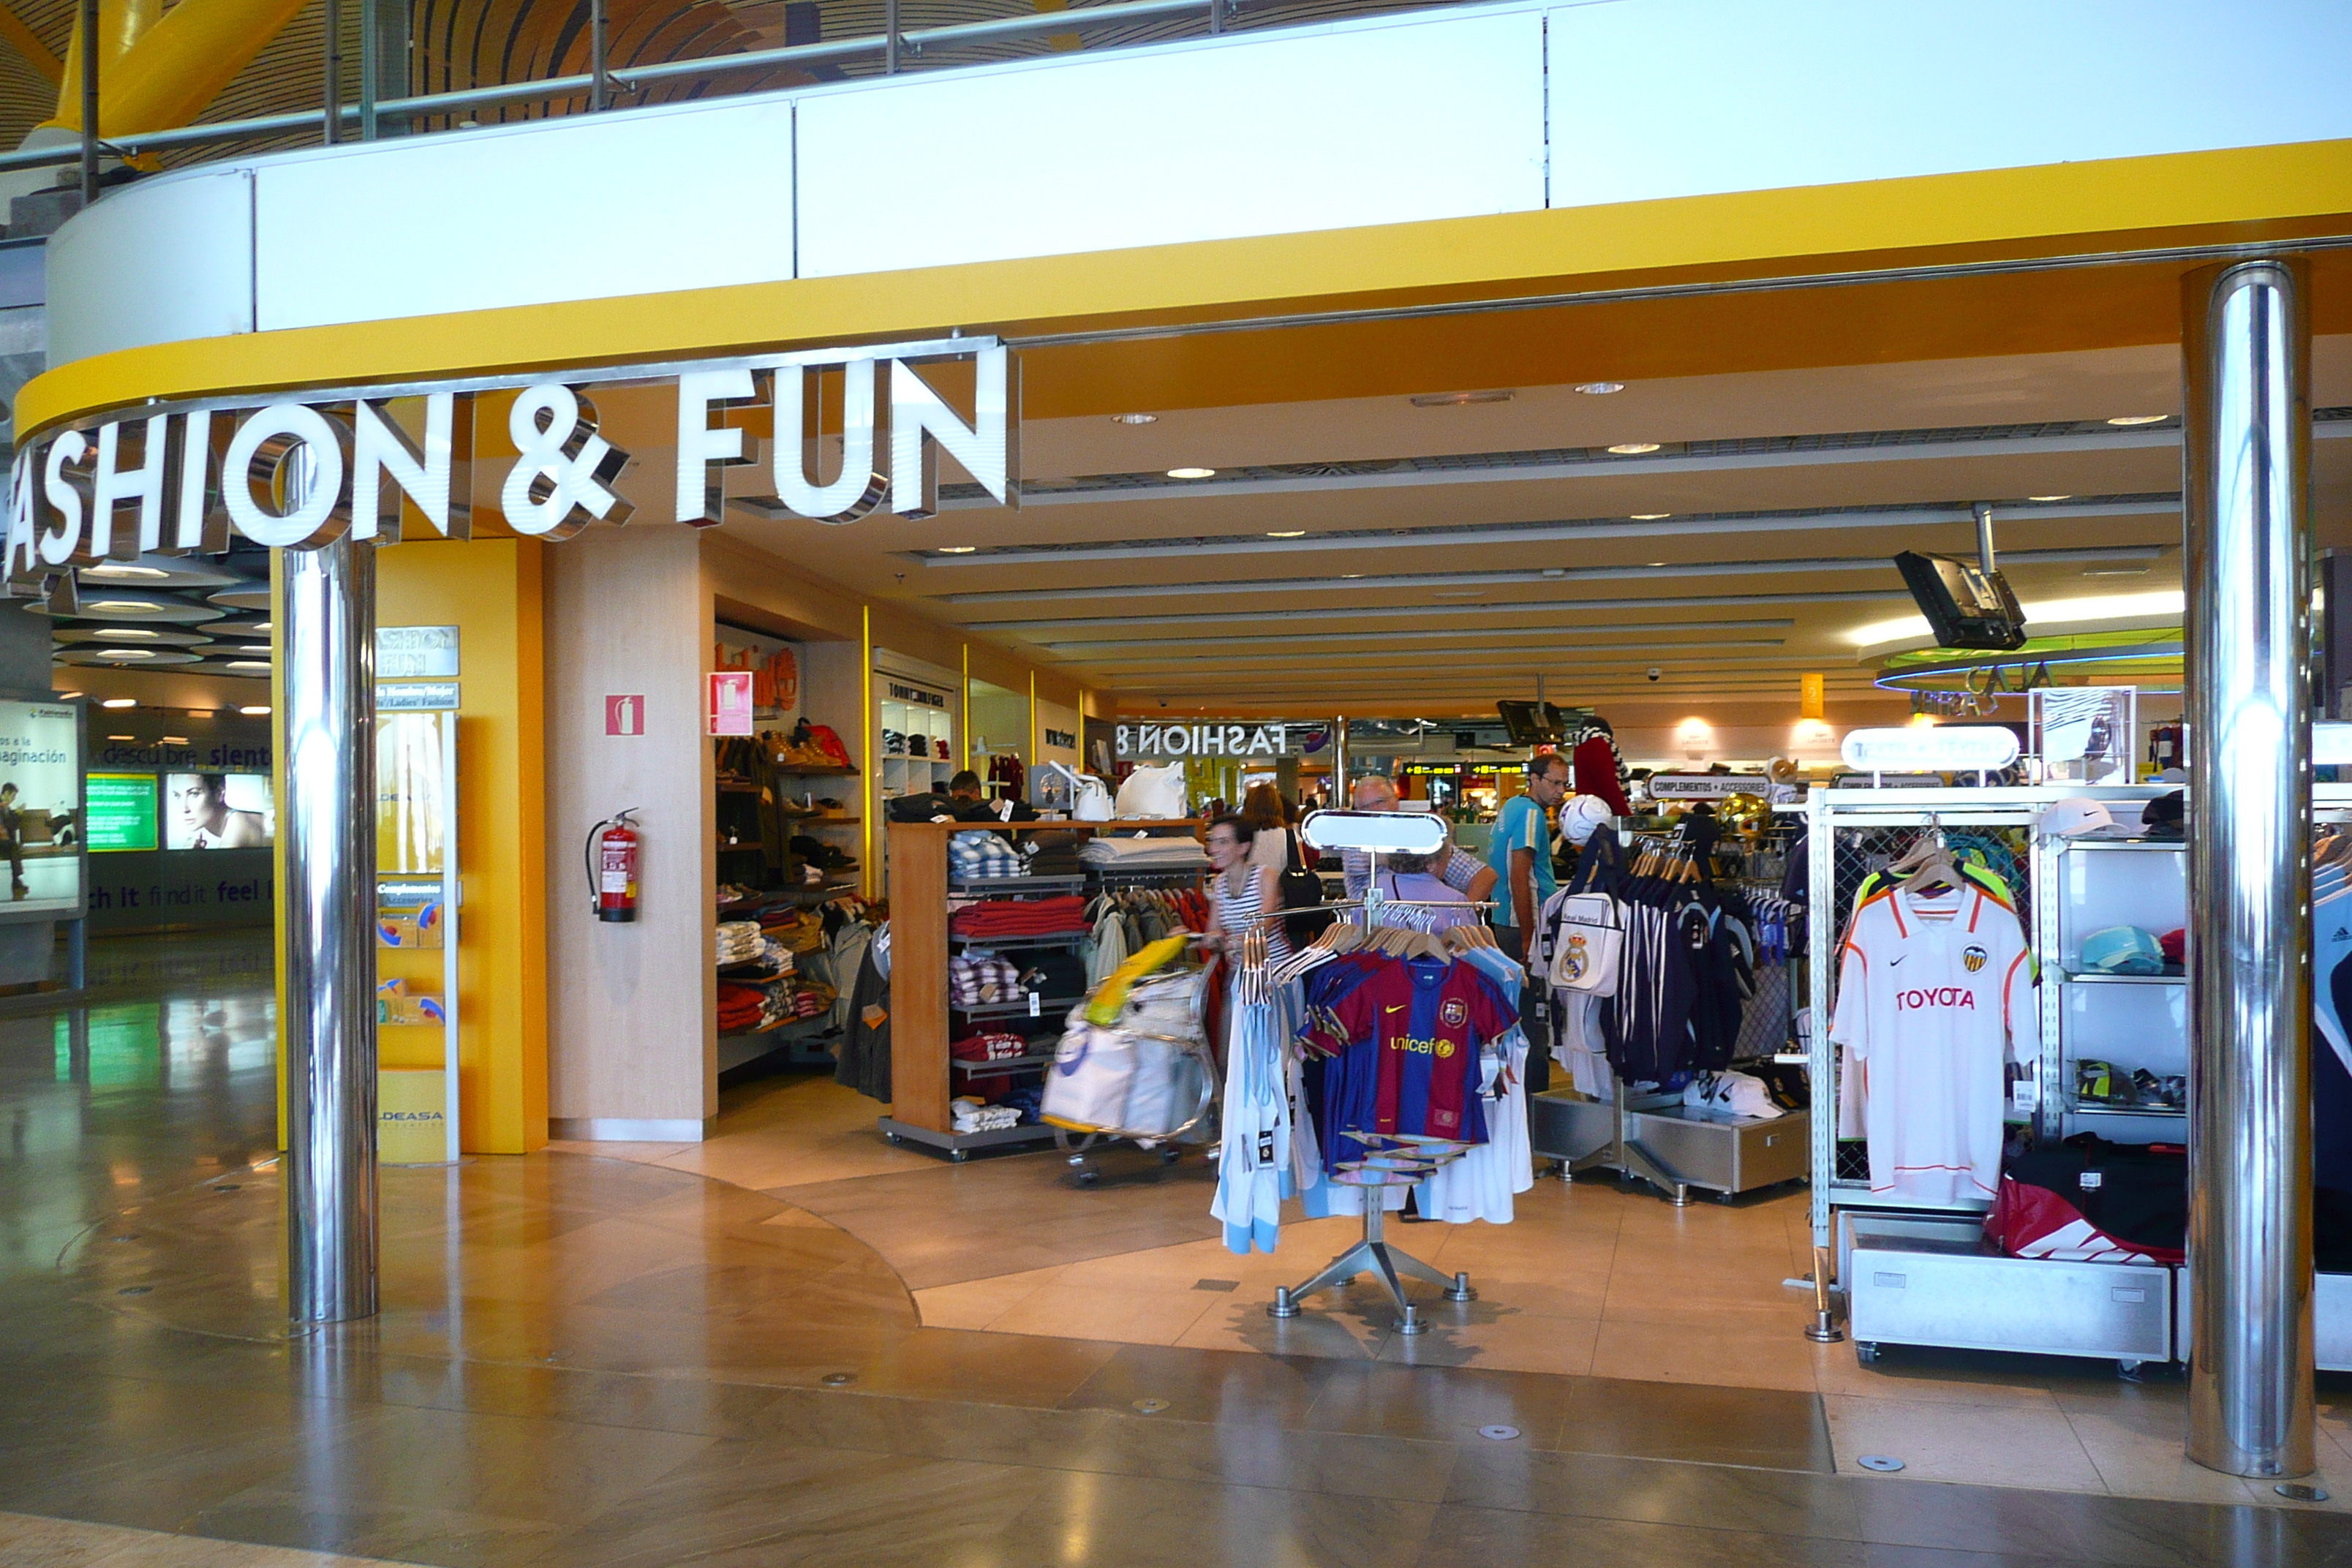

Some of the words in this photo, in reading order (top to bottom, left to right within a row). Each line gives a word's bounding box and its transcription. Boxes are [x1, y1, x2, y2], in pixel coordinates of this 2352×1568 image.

[502, 385, 619, 535] &
[676, 344, 1007, 522] FUN
[1654, 781, 1712, 793] COMPLEMENTOS
[1719, 782, 1766, 793] ACCESSORIES
[218, 879, 259, 902] feel
[1896, 987, 1975, 1011] TOYOTA
[1391, 1033, 1435, 1055] unicef
